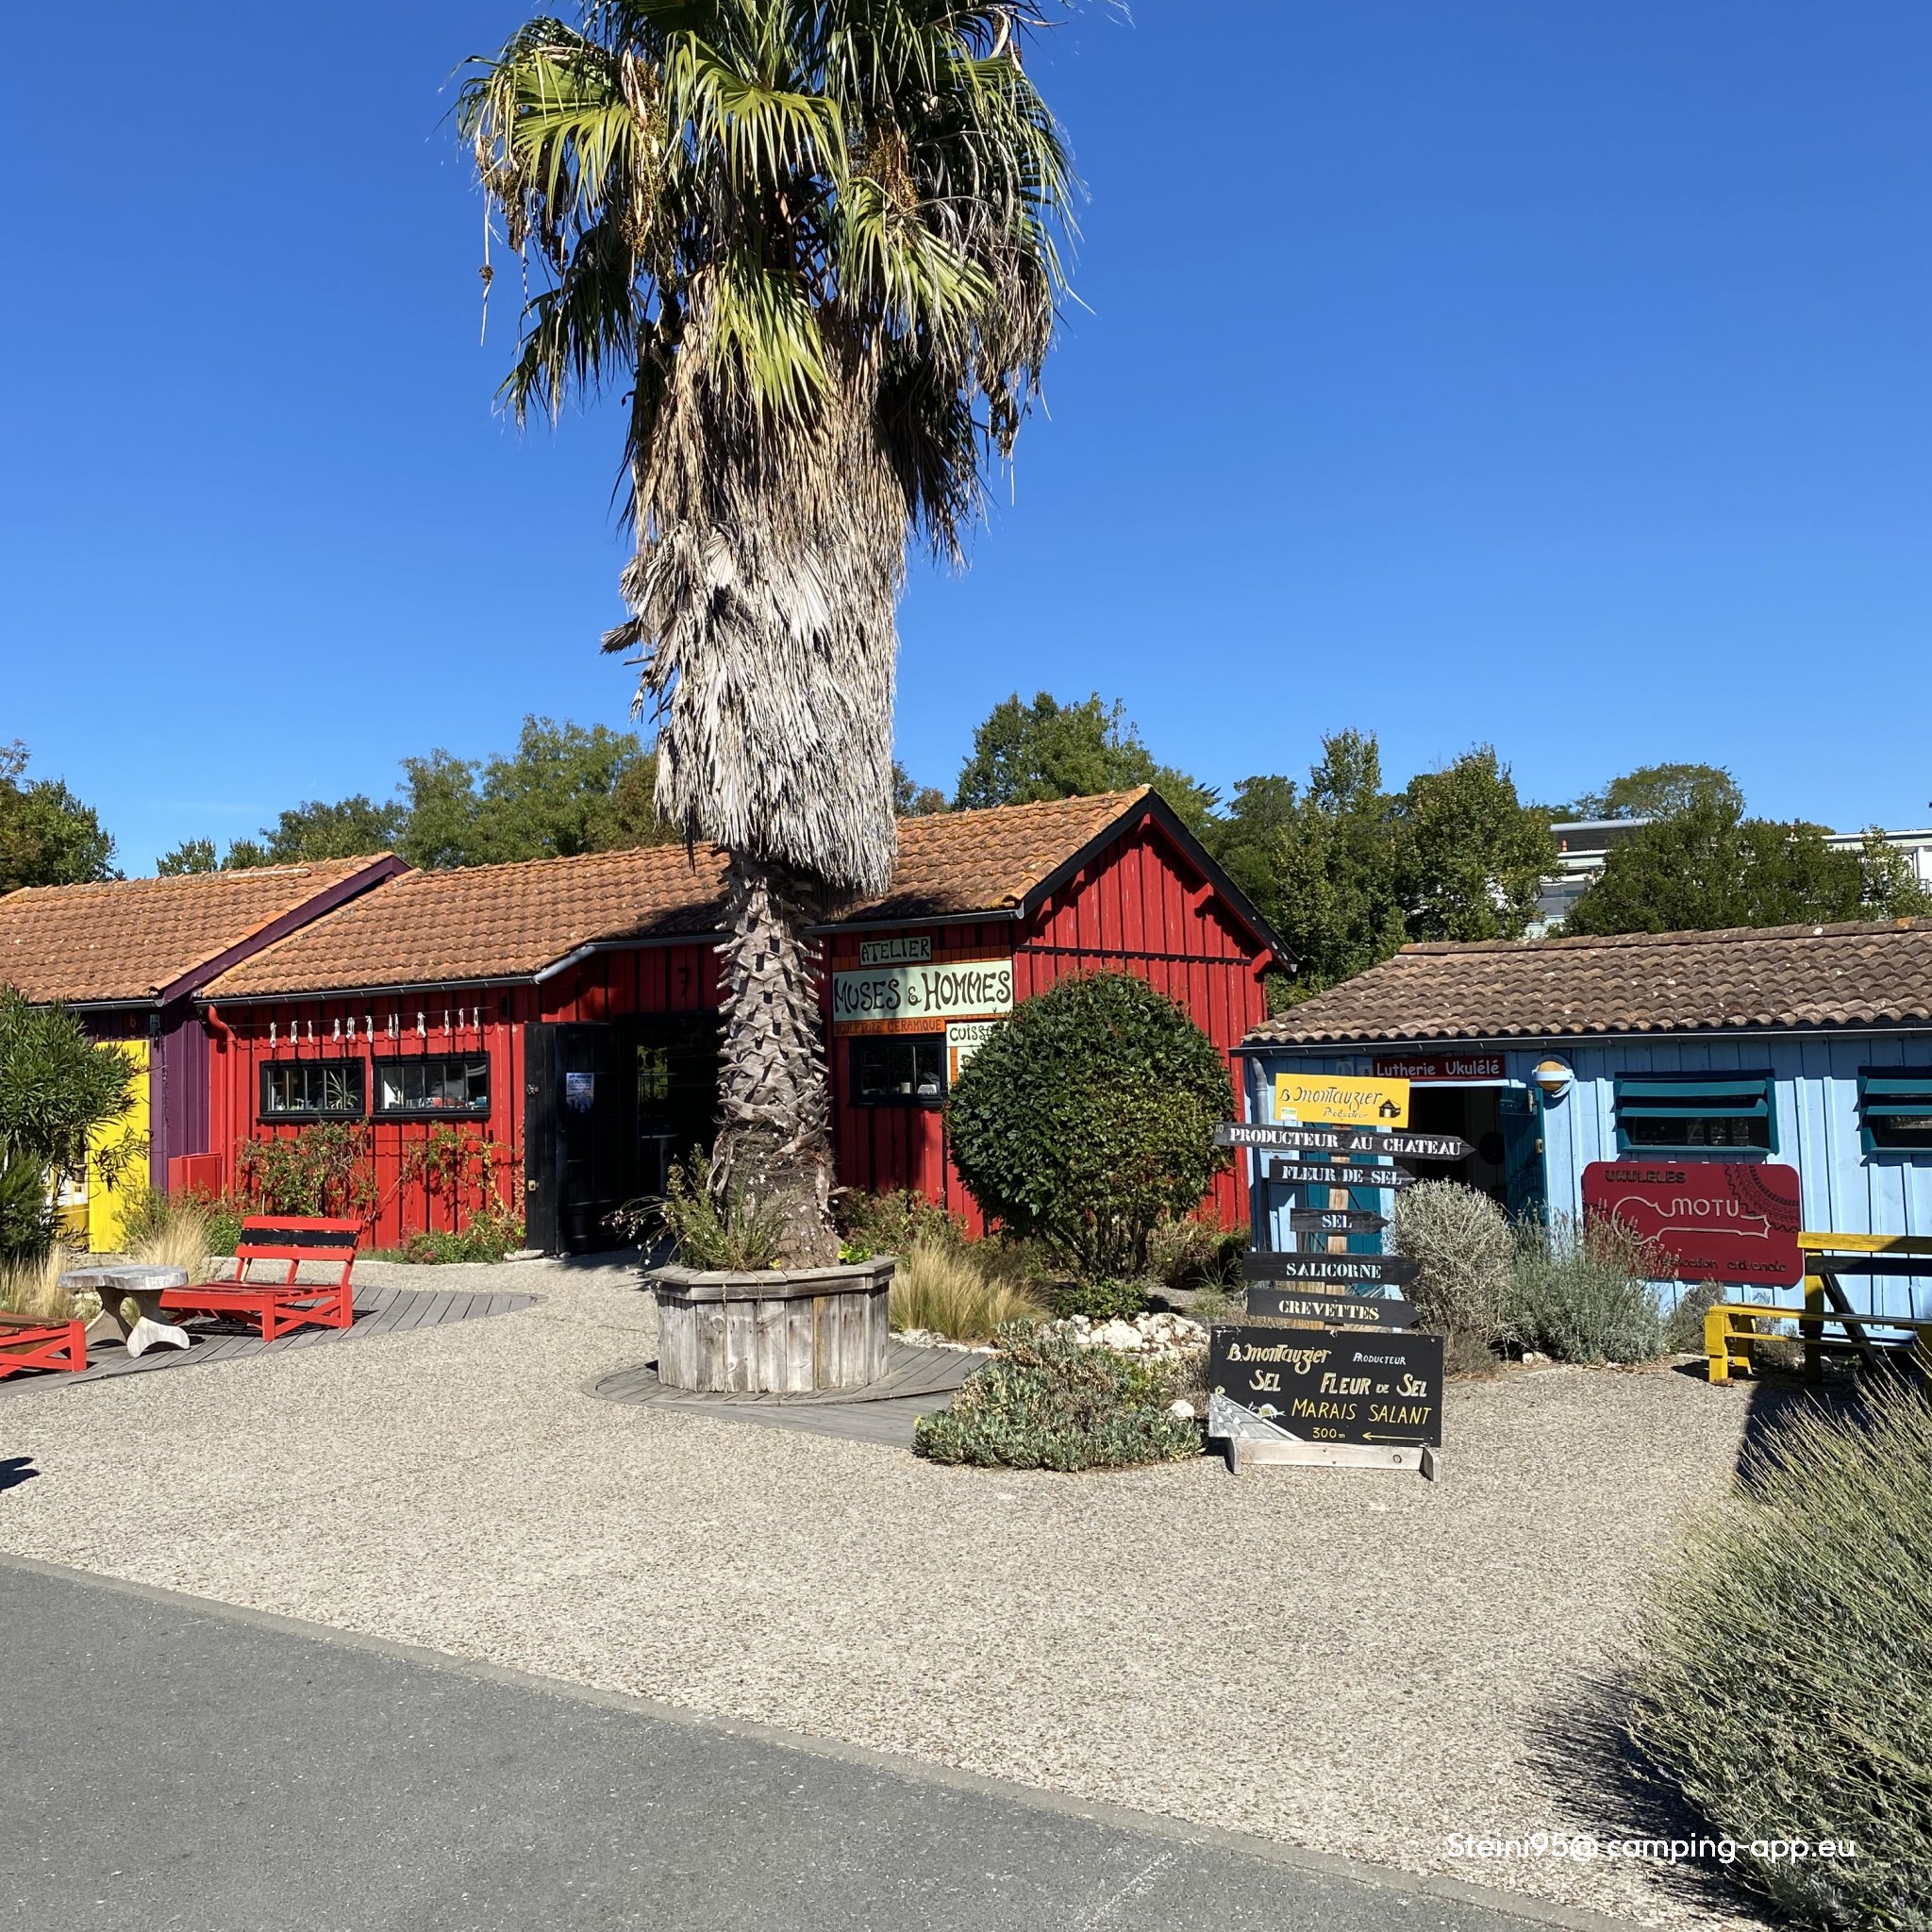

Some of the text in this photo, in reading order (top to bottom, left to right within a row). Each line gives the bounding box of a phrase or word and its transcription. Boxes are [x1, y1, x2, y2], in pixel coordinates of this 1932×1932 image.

[860, 938, 930, 961] ATELIER
[834, 970, 1011, 1013] MUSES & HOMMES
[836, 1019, 941, 1036] SCULPTURE CERAMIQUE
[949, 1024, 994, 1041] CUISSO
[1376, 1058, 1500, 1077] Lutherie Ukulélé
[1324, 1107, 1369, 1119] Producteur
[1229, 1127, 1461, 1156] PRODUCTEUR AU CHATEAU
[1282, 1165, 1402, 1186] FLEUR DE SEL
[1605, 1170, 1687, 1184] UKULELES
[1671, 1198, 1740, 1217] MOTU
[1322, 1214, 1353, 1229] SEL
[1286, 1262, 1382, 1279] SALICORNE
[1278, 1299, 1380, 1321] CREVETTES
[1353, 1352, 1407, 1366] PRODUCTEUR
[1249, 1369, 1427, 1398] SEL FLEUR DE SEL
[1291, 1398, 1432, 1425] MARAIS SALANT
